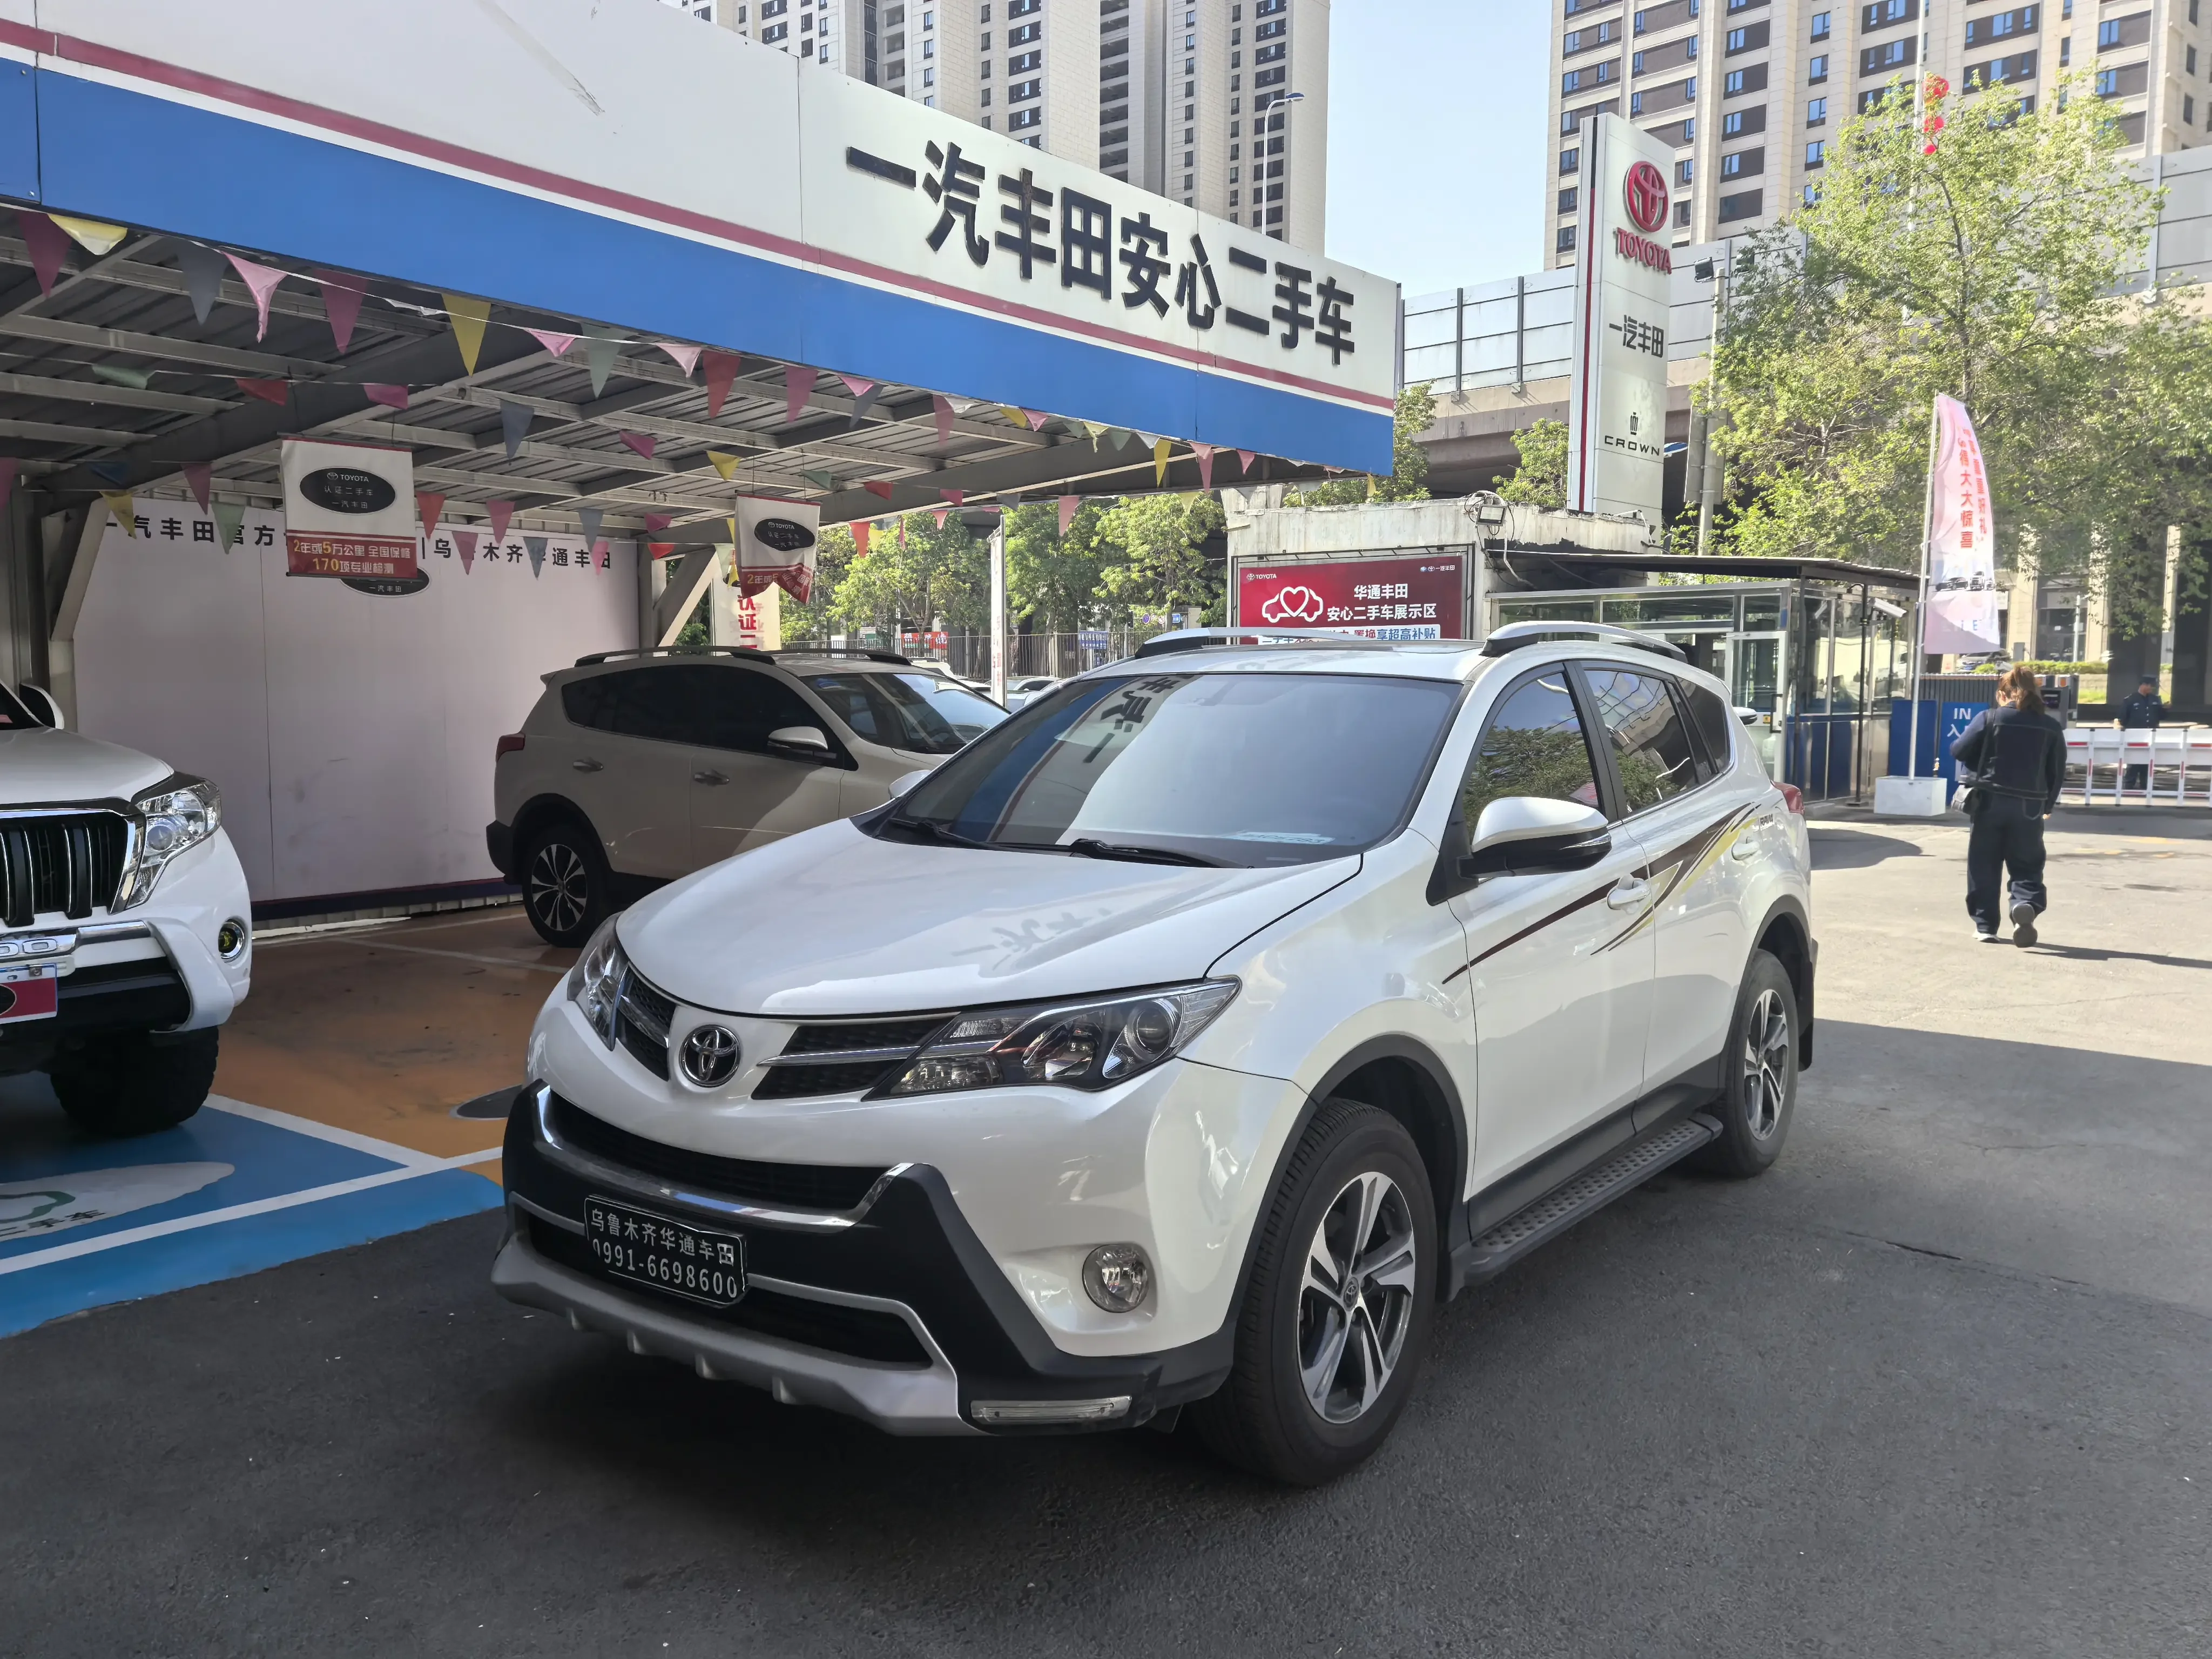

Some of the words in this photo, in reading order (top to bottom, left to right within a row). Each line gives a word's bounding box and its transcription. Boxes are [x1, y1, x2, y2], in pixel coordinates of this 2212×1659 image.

[846, 140, 1355, 366] 一汽丰田安心二手车
[1616, 227, 1672, 275] TOYOTA
[1609, 314, 1664, 358] 一汽丰田
[1604, 435, 1660, 456] CROWN
[325, 485, 374, 496] 认证二手车
[332, 501, 368, 509] 一汽丰田
[293, 539, 365, 556] 2年或5万公里
[368, 545, 410, 558] 全国保修
[313, 558, 394, 574] 170项专业检测
[1353, 583, 1408, 600] 华通丰田
[1327, 603, 1437, 621] 安心二手车展示区
[1953, 708, 1971, 719] IN
